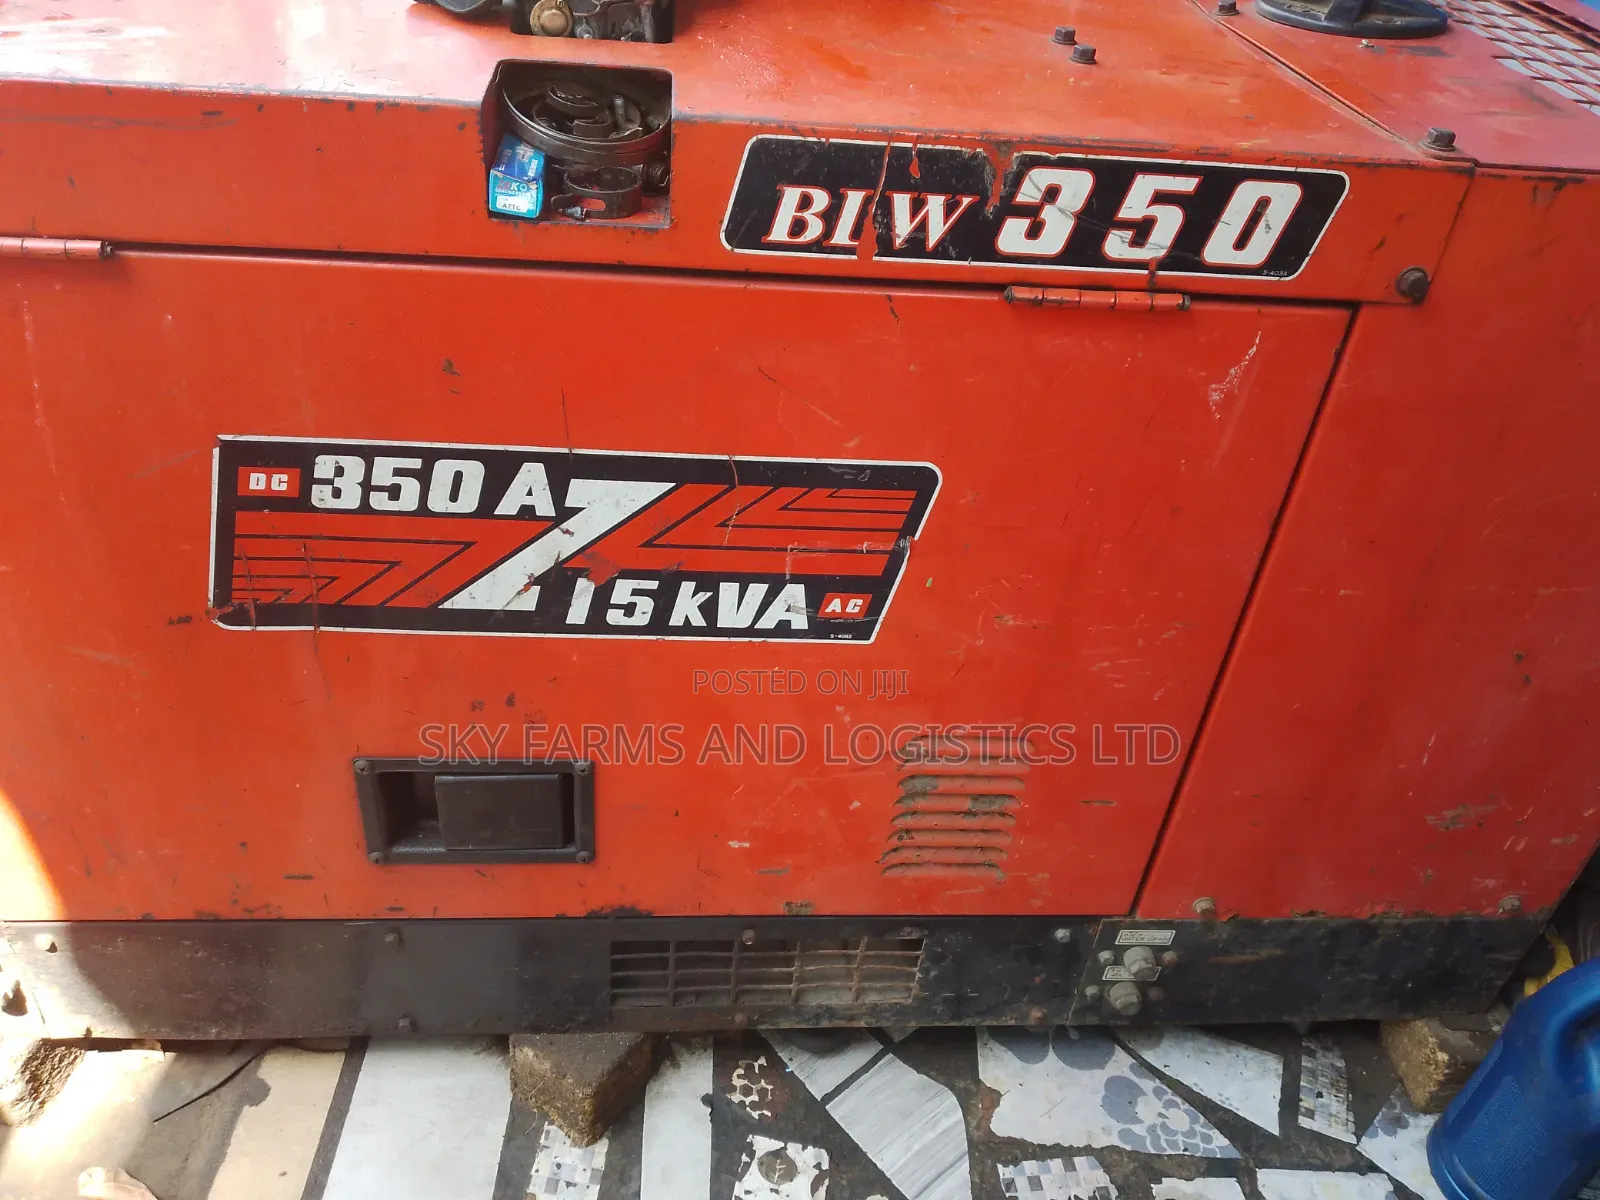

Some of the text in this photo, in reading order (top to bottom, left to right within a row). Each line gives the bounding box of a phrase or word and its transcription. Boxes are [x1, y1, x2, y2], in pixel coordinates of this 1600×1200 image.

[994, 166, 1304, 268] 350
[248, 455, 558, 517] DC 350 A
[564, 577, 653, 628] 15
[825, 598, 864, 613] AC
